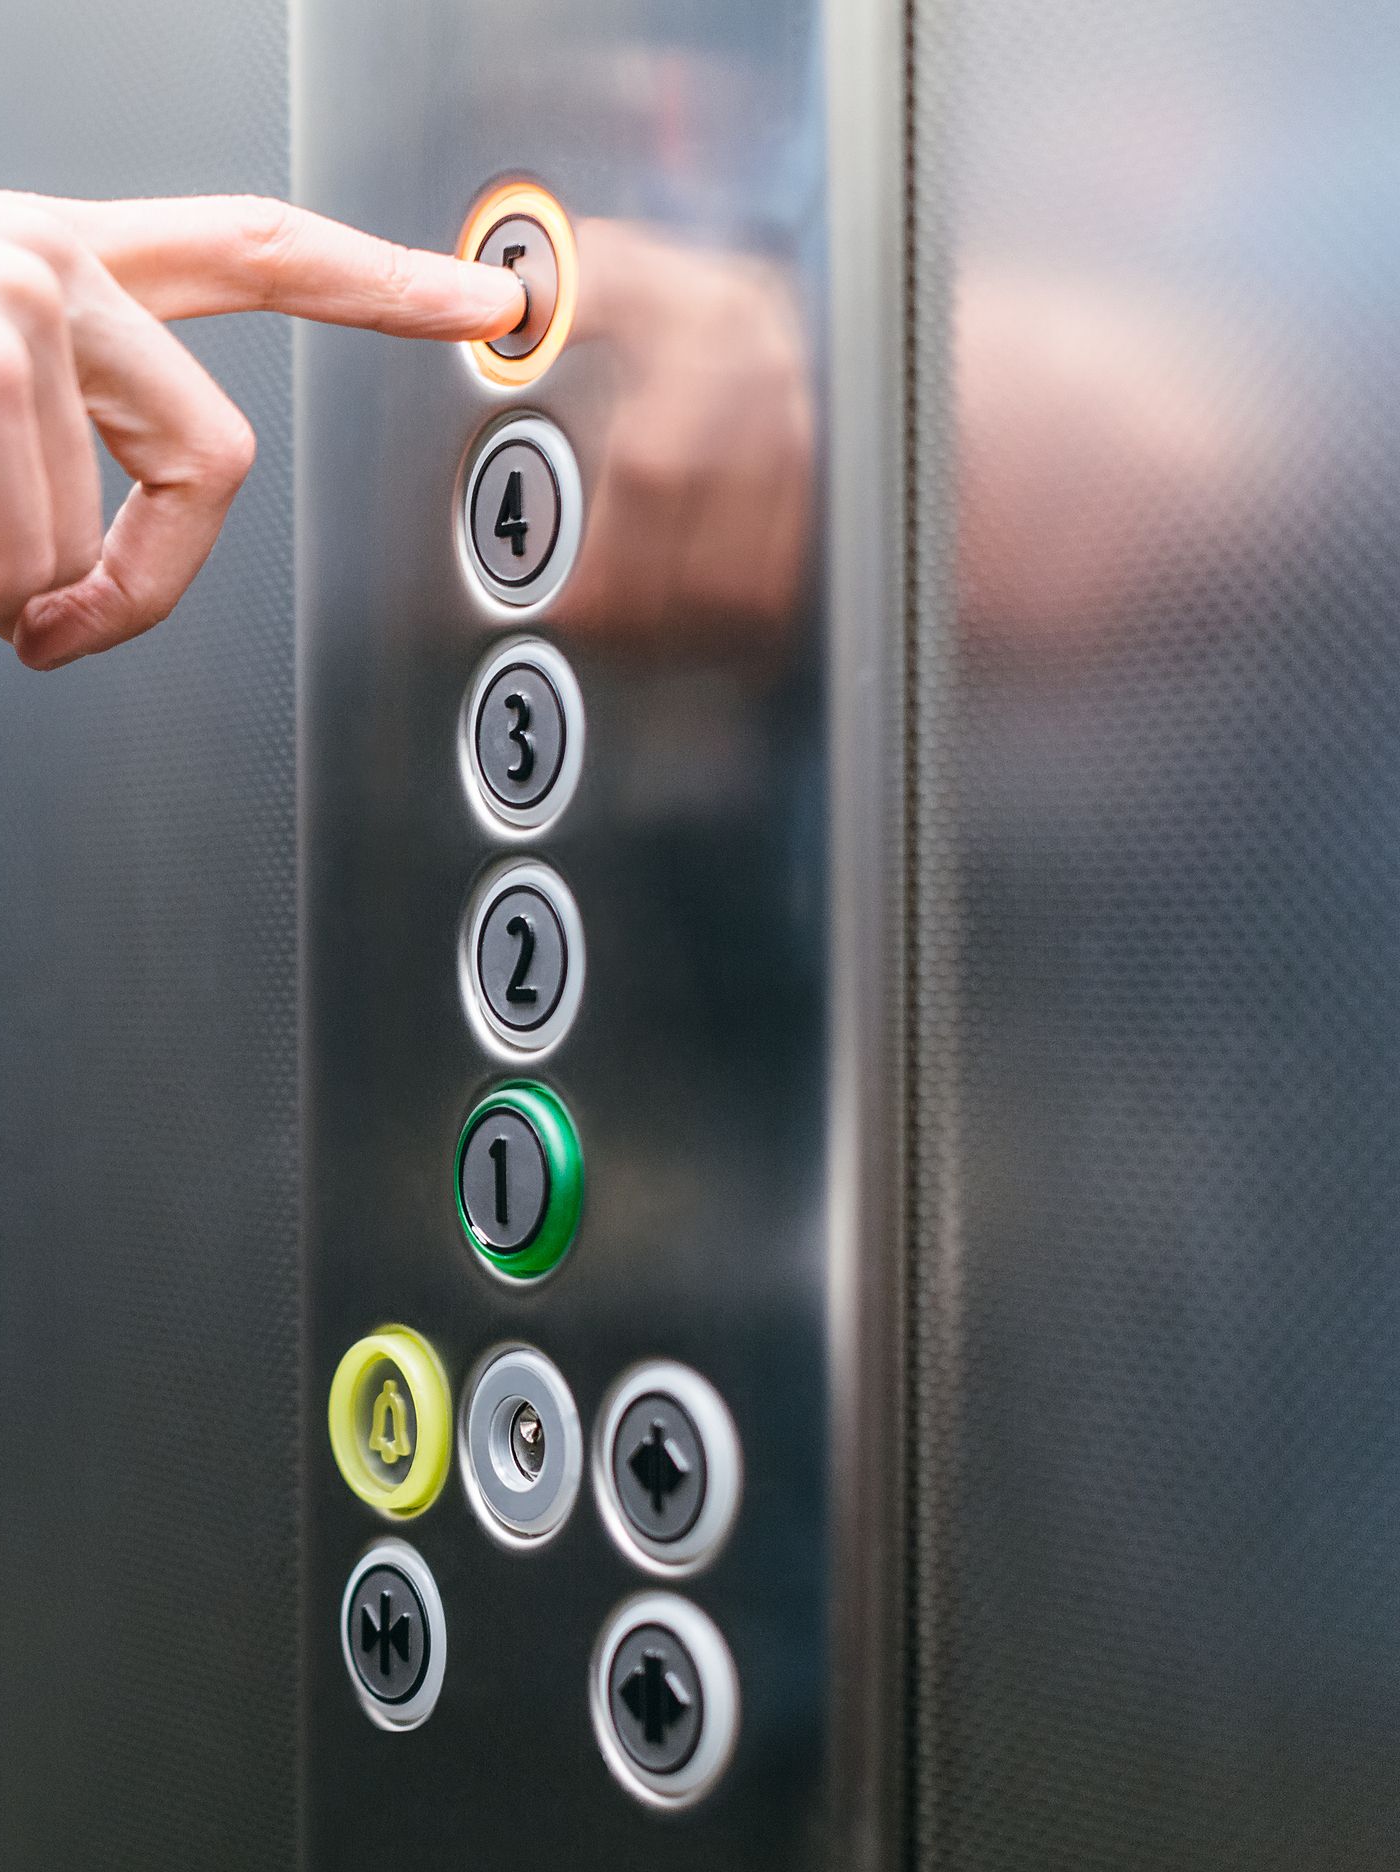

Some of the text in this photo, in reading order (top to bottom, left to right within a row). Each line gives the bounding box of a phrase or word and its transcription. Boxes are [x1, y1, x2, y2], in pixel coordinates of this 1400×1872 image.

[494, 470, 528, 557] 4
[504, 693, 534, 781] 3
[506, 915, 537, 1002] 2
[488, 1137, 508, 1225] 1
